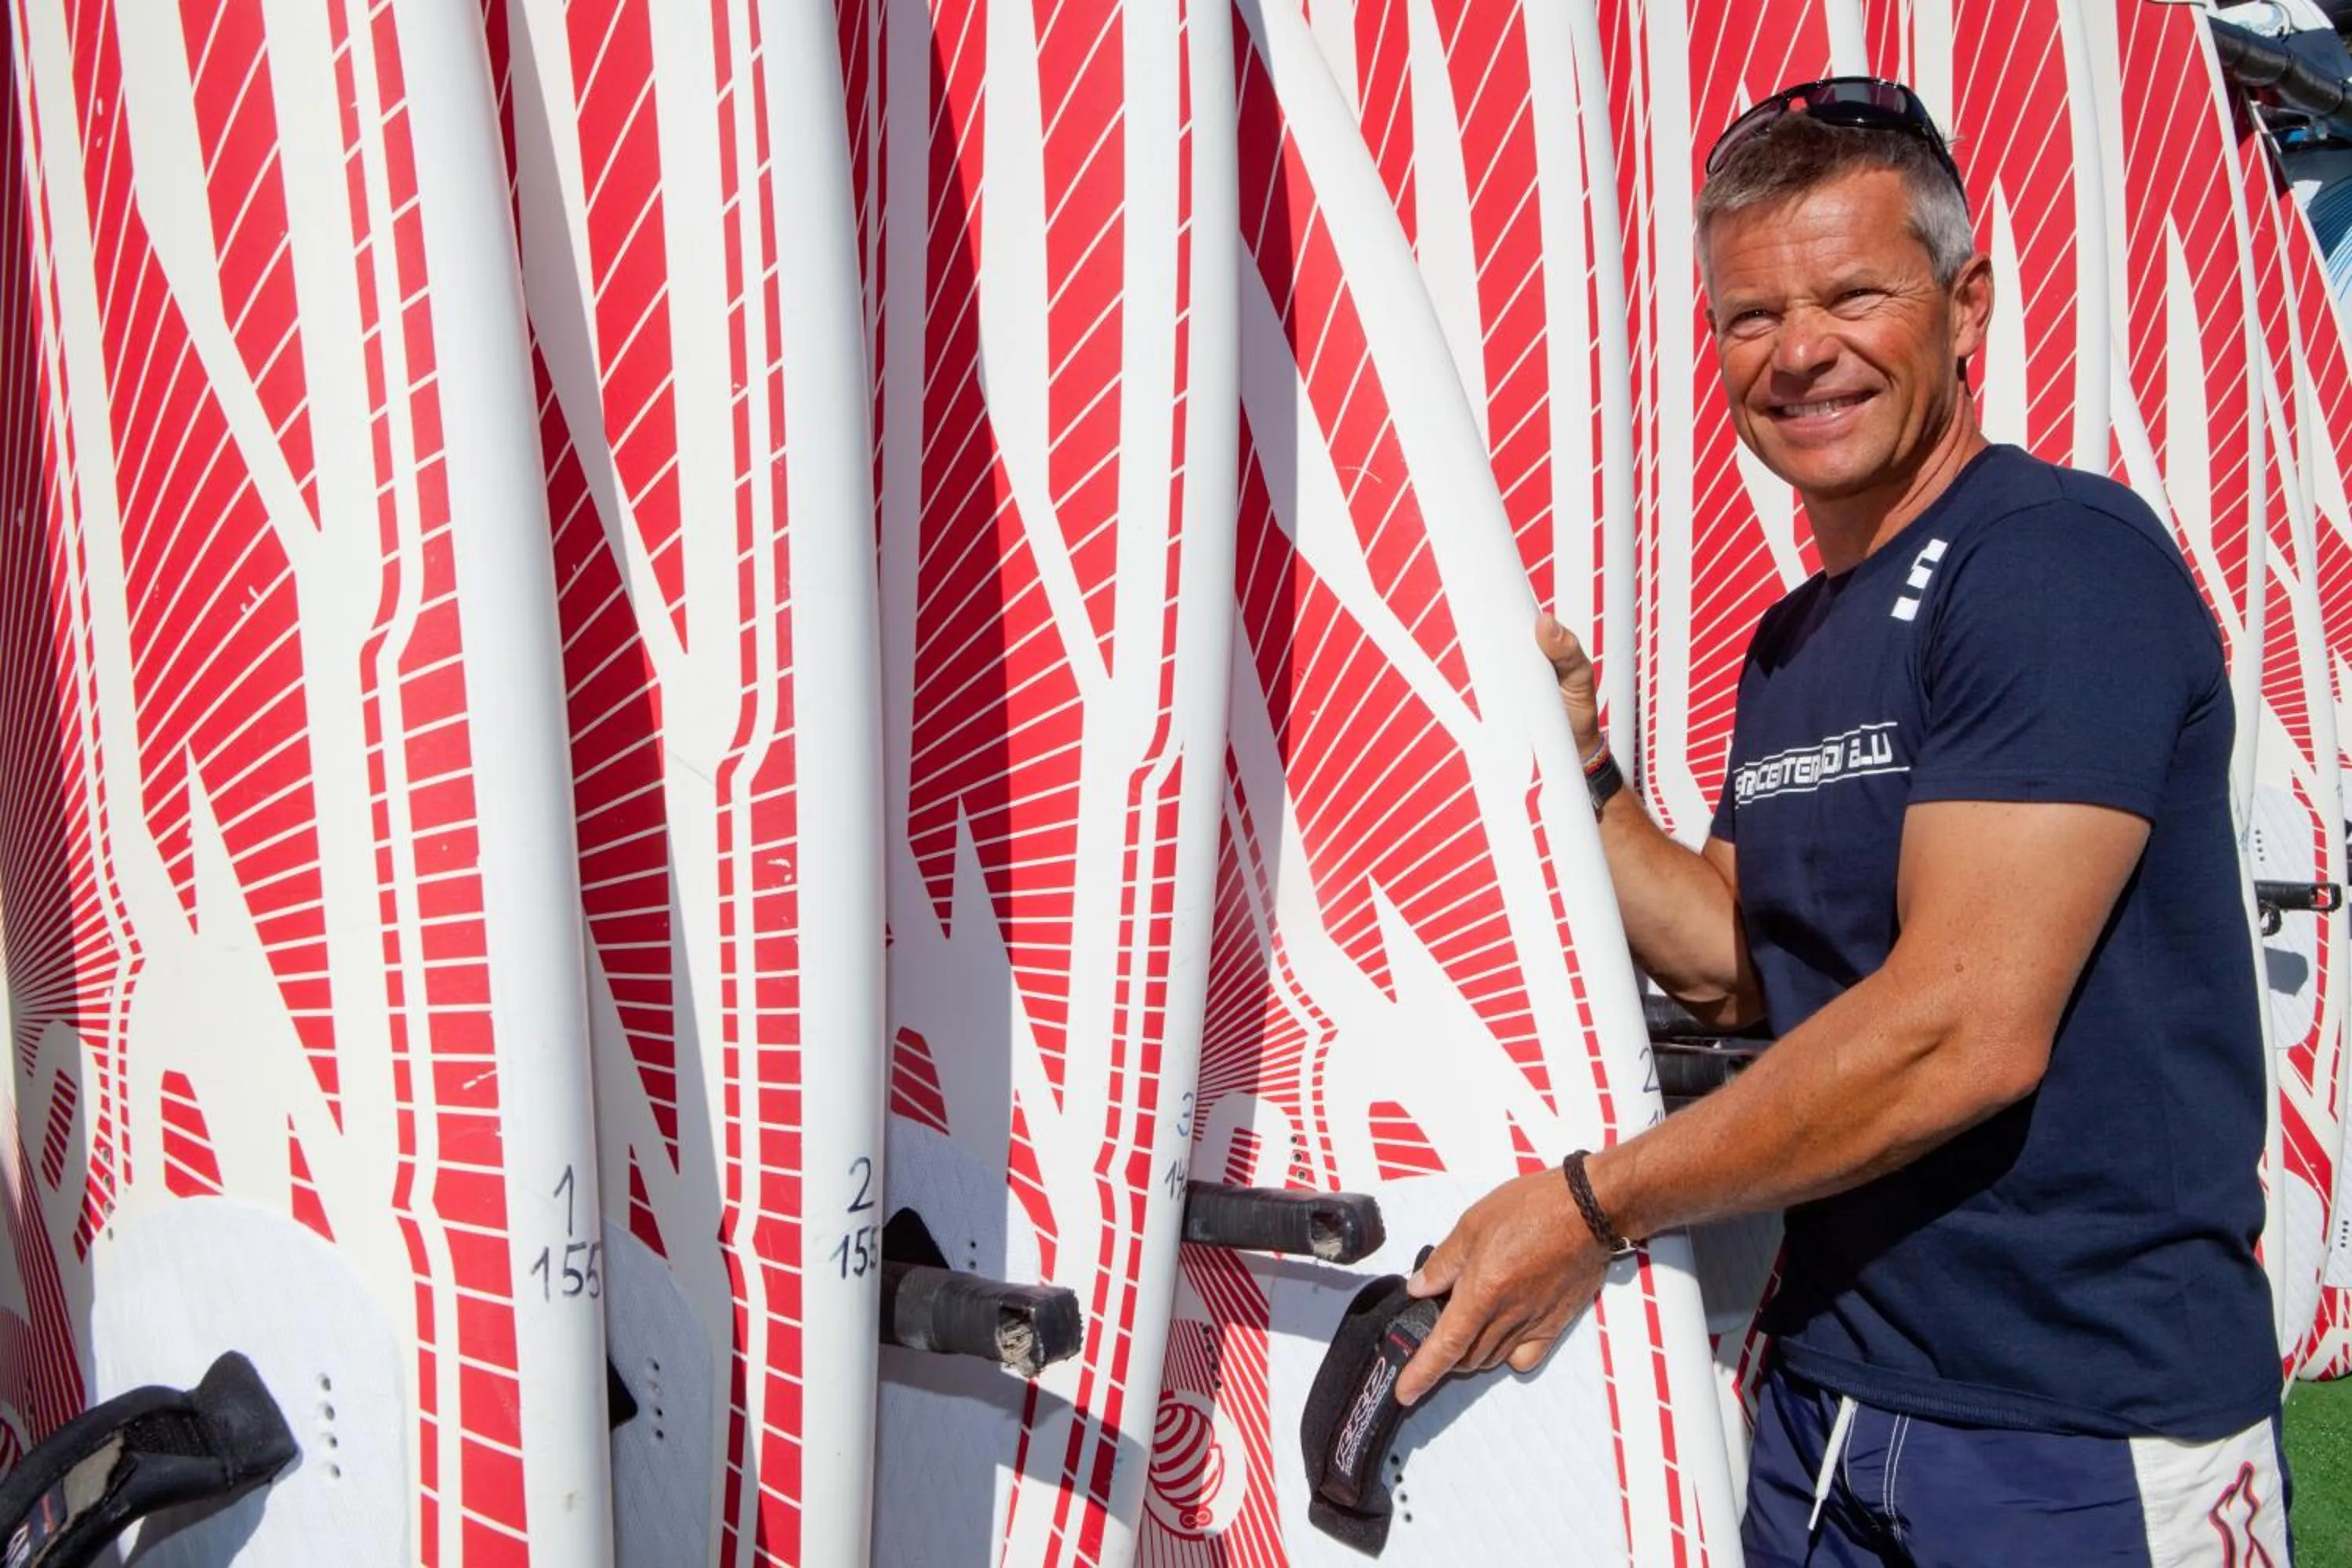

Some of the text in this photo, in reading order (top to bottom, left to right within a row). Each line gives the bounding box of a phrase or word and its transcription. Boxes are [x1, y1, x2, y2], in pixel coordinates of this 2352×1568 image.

[1639, 1047, 1661, 1093] 2
[553, 1163, 574, 1237] 1
[848, 1156, 875, 1213] 2
[530, 1241, 601, 1302] 155
[829, 1225, 880, 1279] 155
